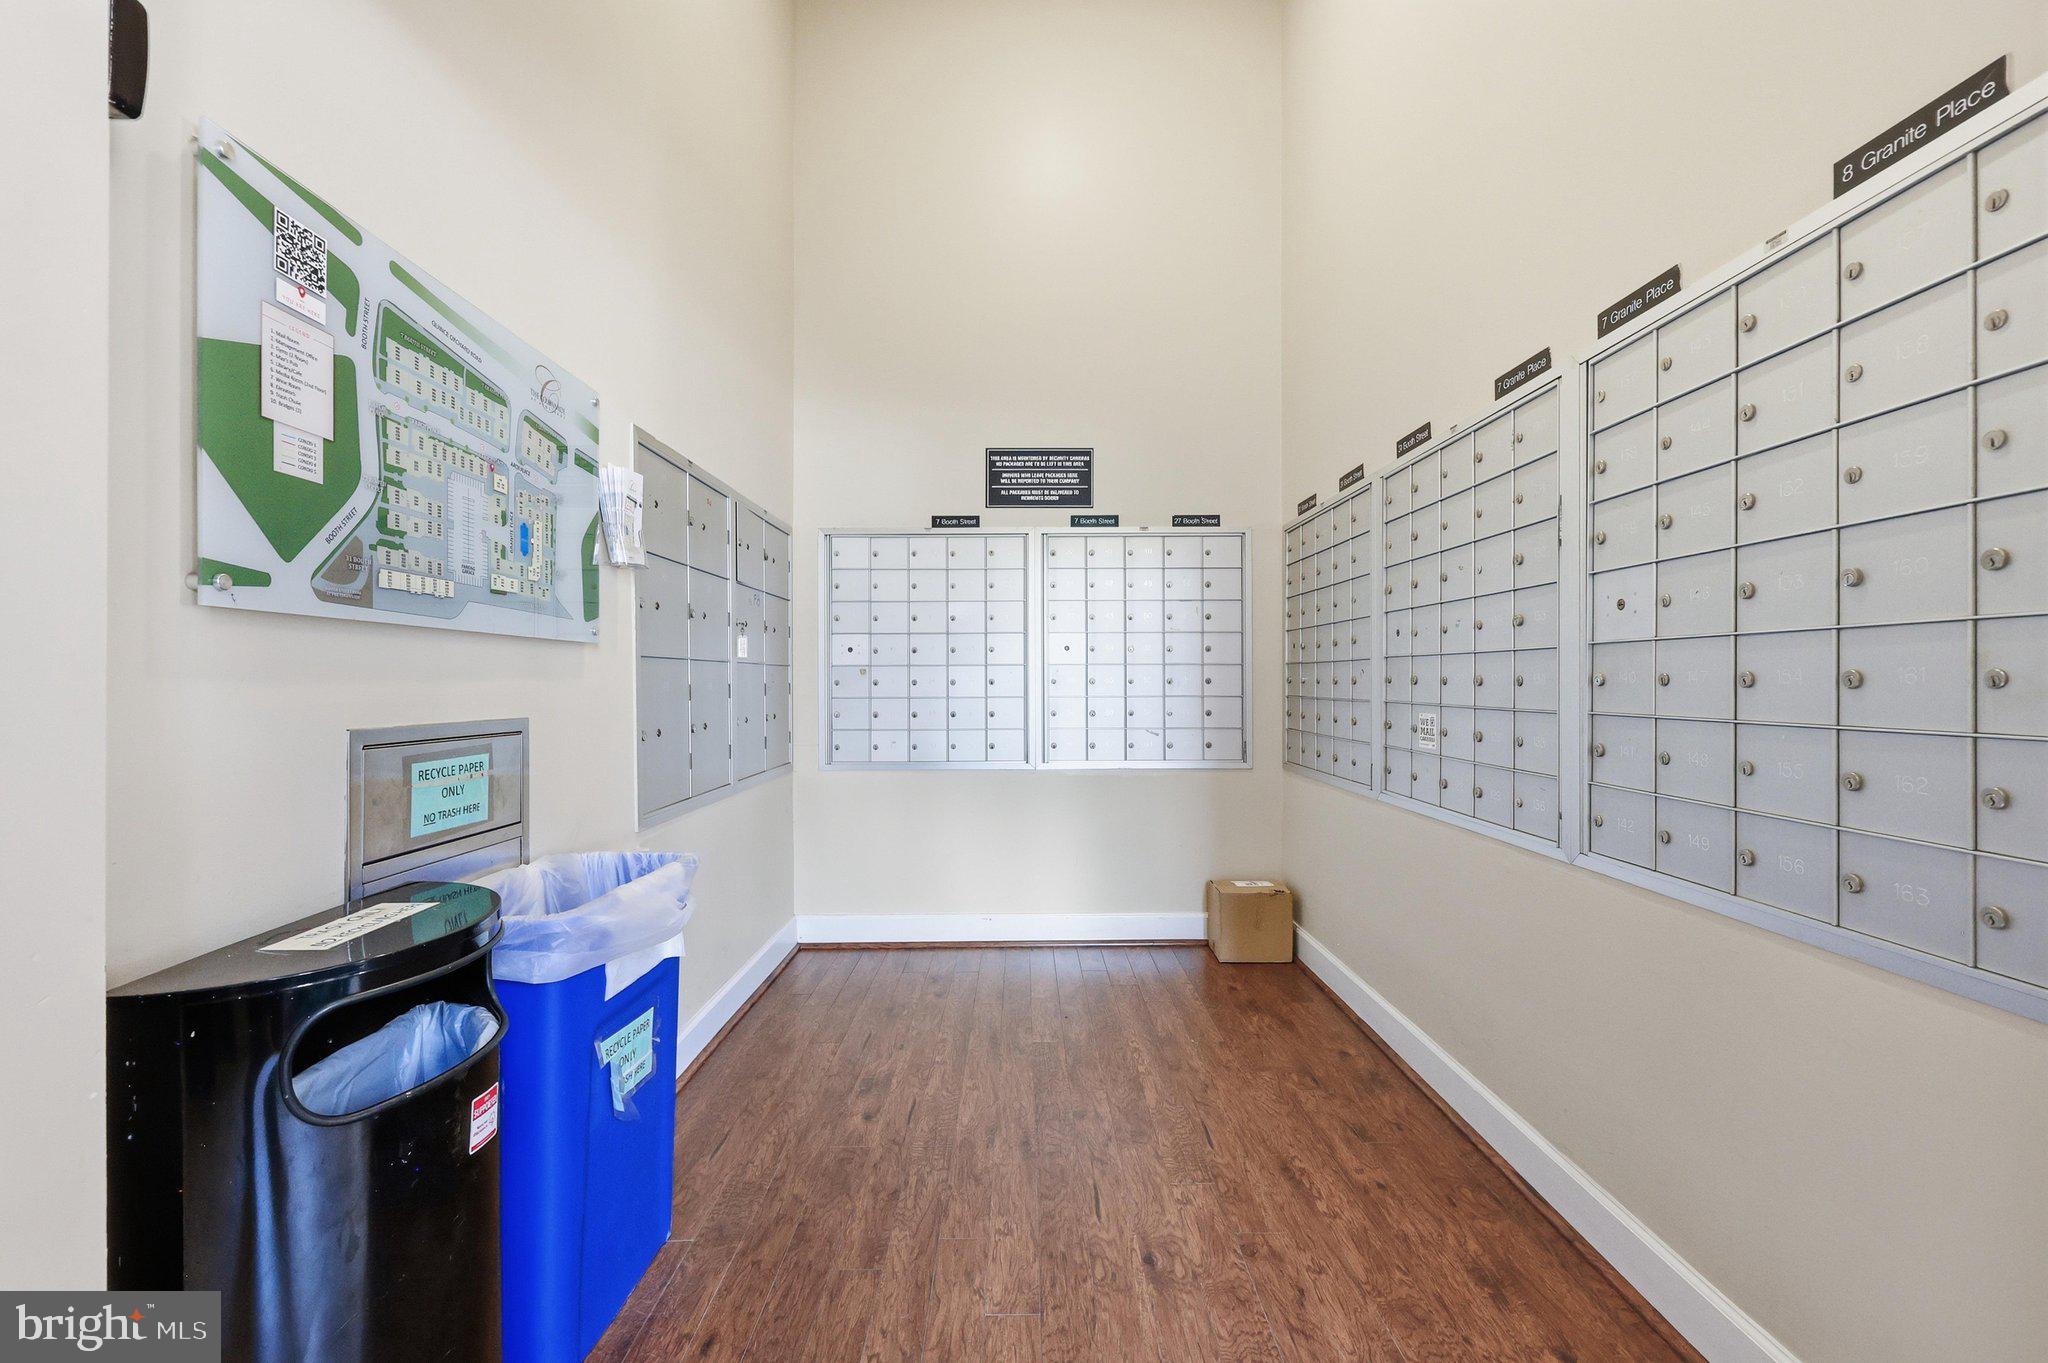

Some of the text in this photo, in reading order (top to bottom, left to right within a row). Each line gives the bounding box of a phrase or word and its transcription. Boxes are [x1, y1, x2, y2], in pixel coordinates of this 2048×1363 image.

[1842, 80, 1997, 183] 8 Granite Place
[1601, 277, 1675, 330] 7 Granite Place
[360, 323, 369, 350] BOOTH
[1503, 369, 1526, 391] Granite
[1526, 356, 1547, 375] Place
[1415, 428, 1429, 442] Street
[324, 506, 358, 545] BOOTH STREET
[1080, 517, 1098, 525] Booth
[1098, 517, 1115, 525] Street
[1183, 517, 1200, 525] Booth
[1200, 517, 1218, 525] Street
[418, 761, 485, 782] RECYCLE PAPER
[441, 784, 466, 799] ONLY
[1893, 774, 1931, 797] 162
[423, 802, 481, 825] NO TRASH HERE
[1616, 816, 1635, 834] 142
[1687, 833, 1711, 851] 149
[1777, 854, 1806, 876] 156
[1893, 881, 1931, 907] 163
[604, 1018, 651, 1060] RECYCLE PAPER
[619, 1047, 637, 1069] ONLY
